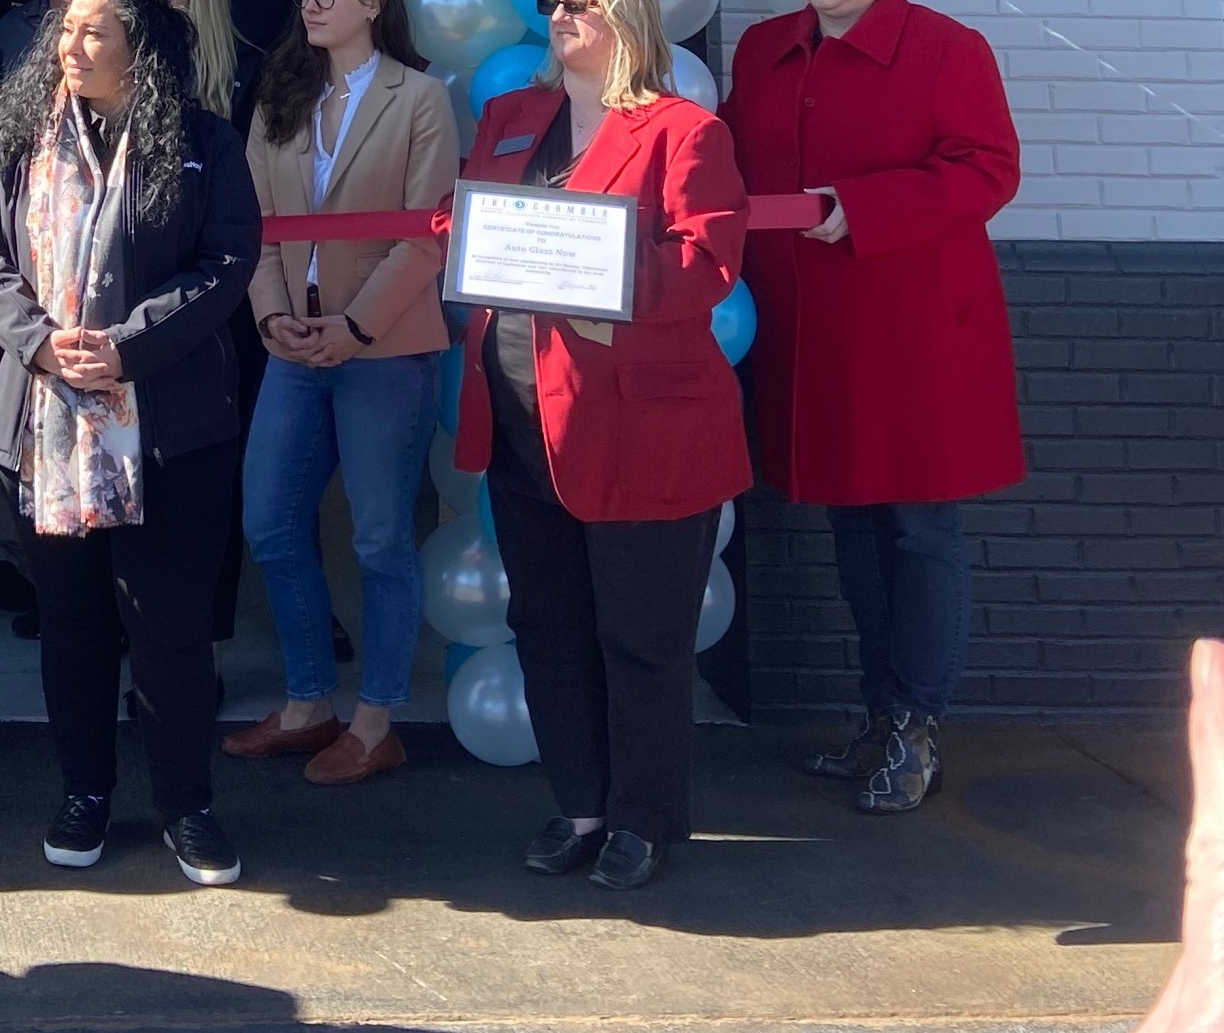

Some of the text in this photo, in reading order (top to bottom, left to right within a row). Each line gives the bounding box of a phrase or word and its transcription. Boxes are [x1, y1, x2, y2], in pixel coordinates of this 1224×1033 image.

[533, 201, 608, 218] CHAMBER
[504, 243, 577, 258] Auto Glass Now
